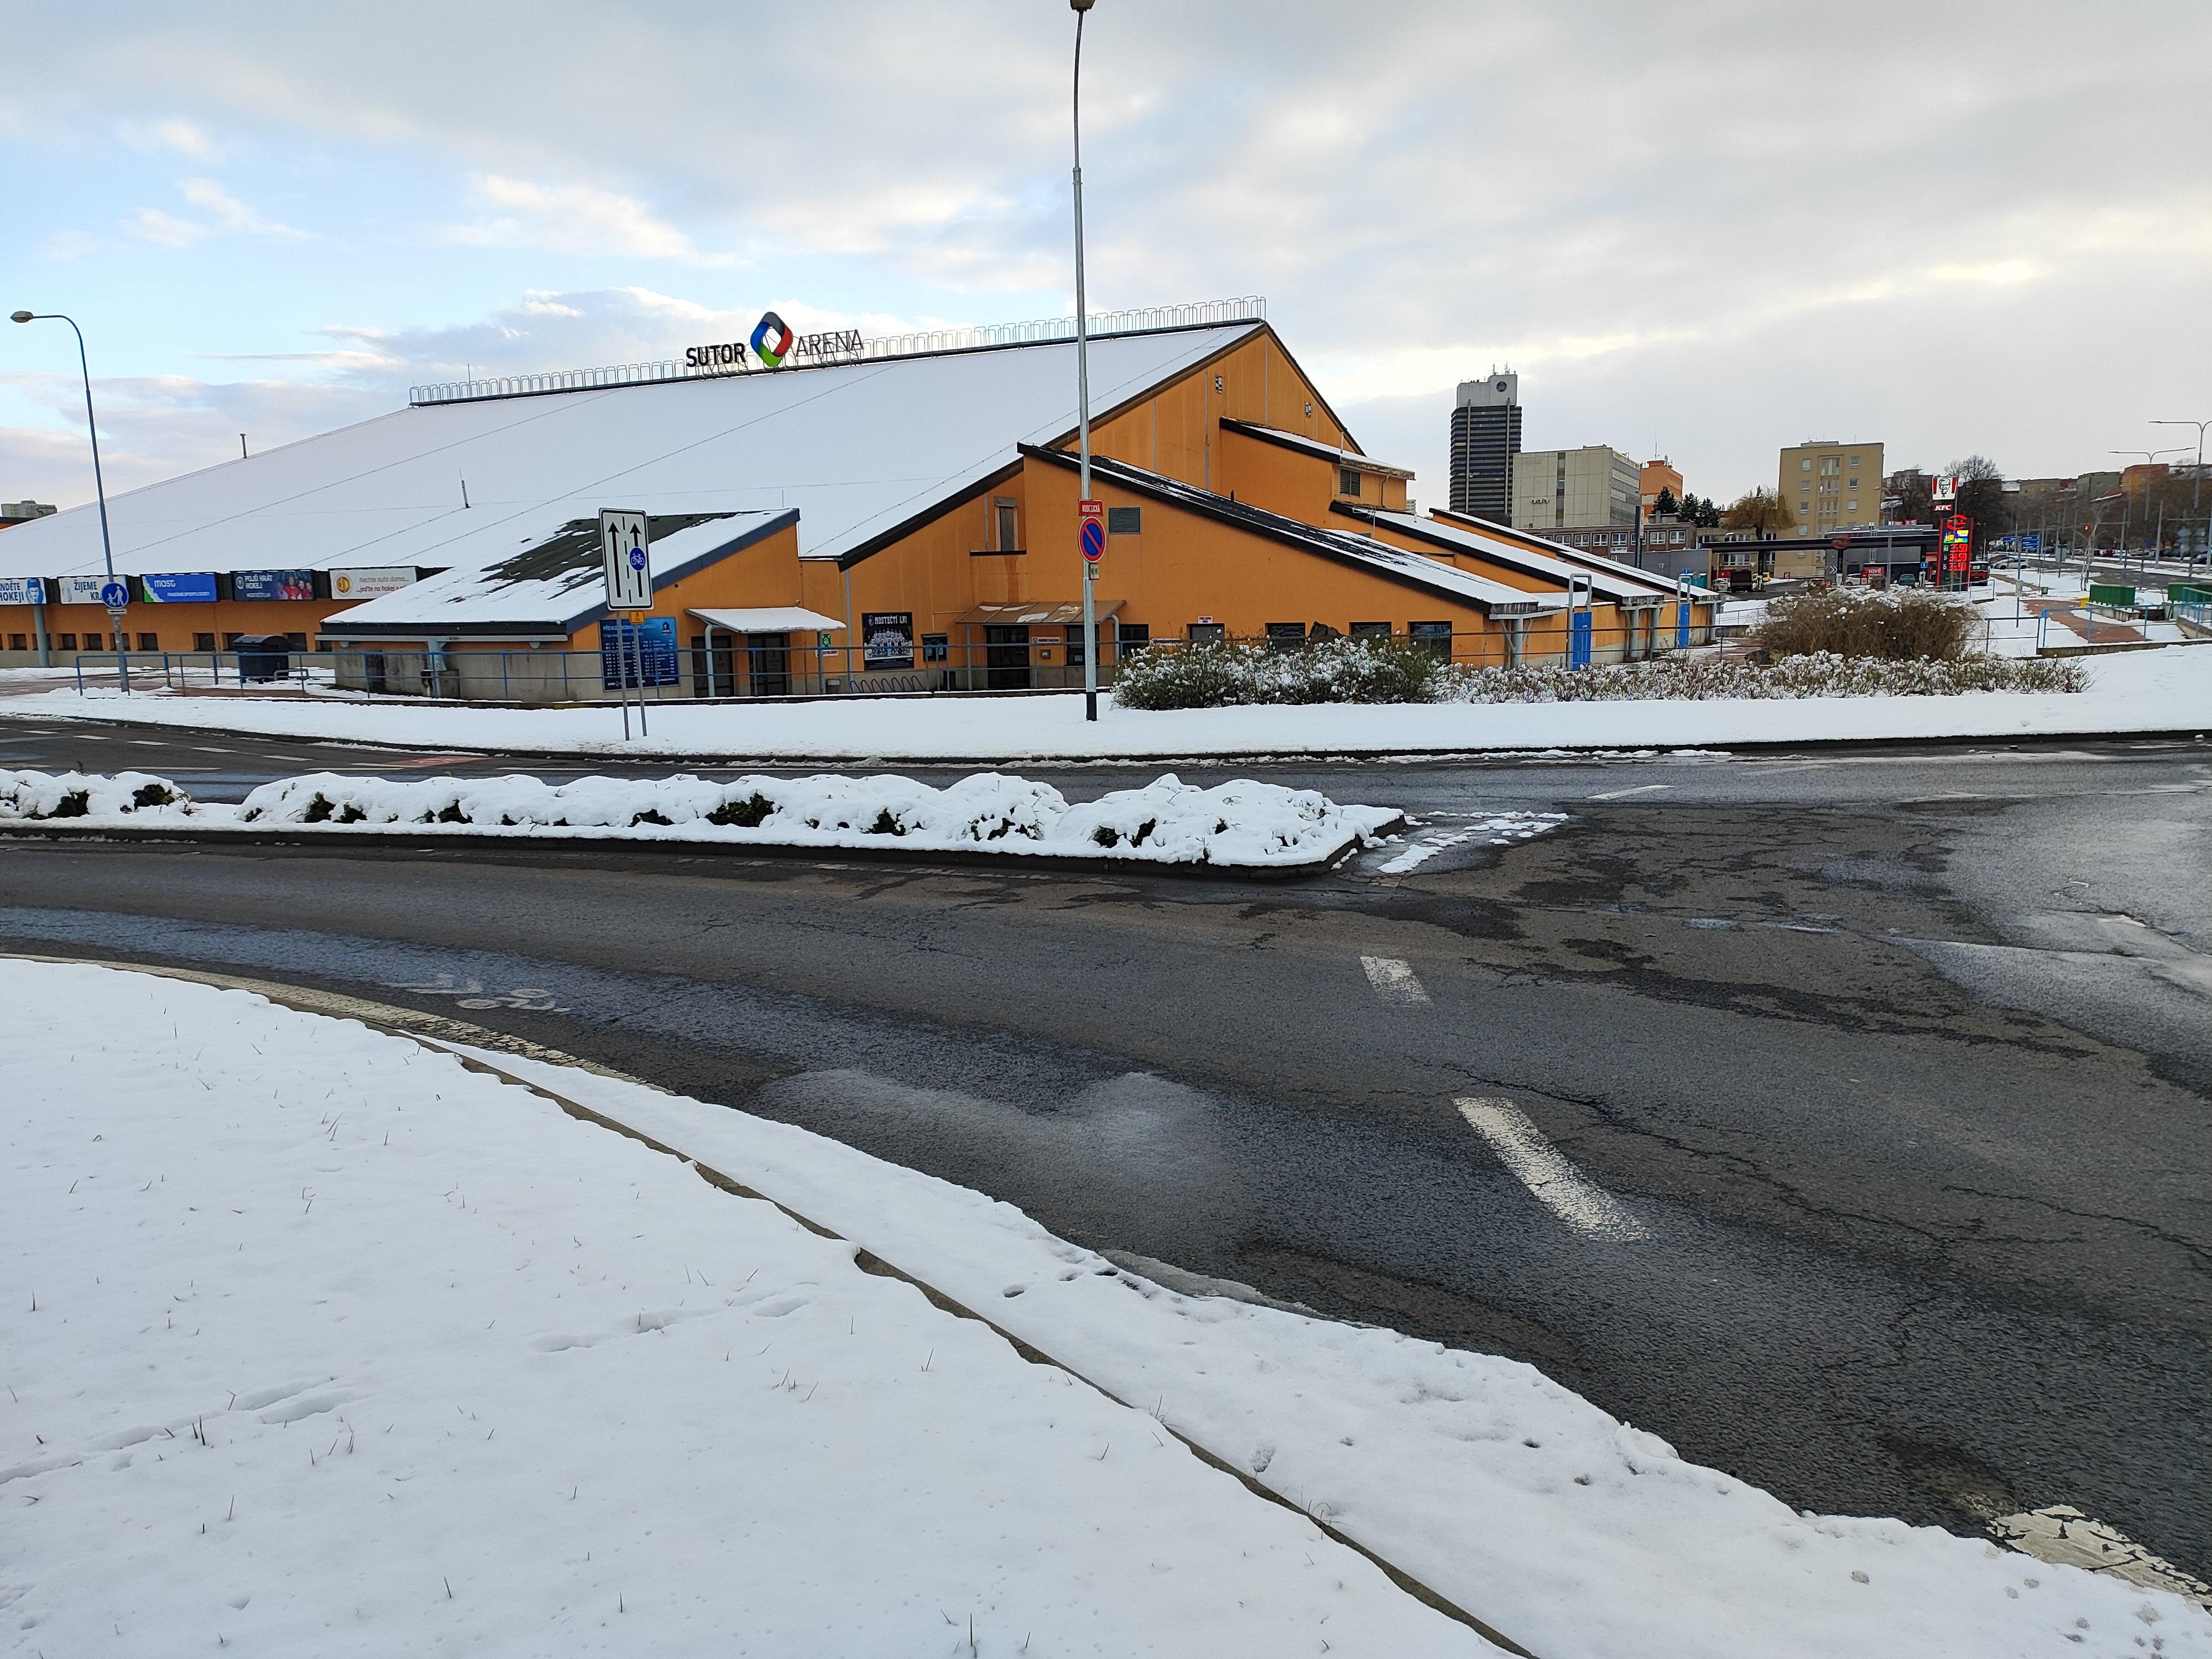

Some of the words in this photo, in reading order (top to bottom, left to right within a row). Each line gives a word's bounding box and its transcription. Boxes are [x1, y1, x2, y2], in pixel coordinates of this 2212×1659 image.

[686, 342, 746, 367] SUTOR
[795, 328, 864, 357] ARENA
[74, 580, 98, 593] ŽIJEME
[90, 592, 103, 601] KR
[899, 615, 907, 624] LVI
